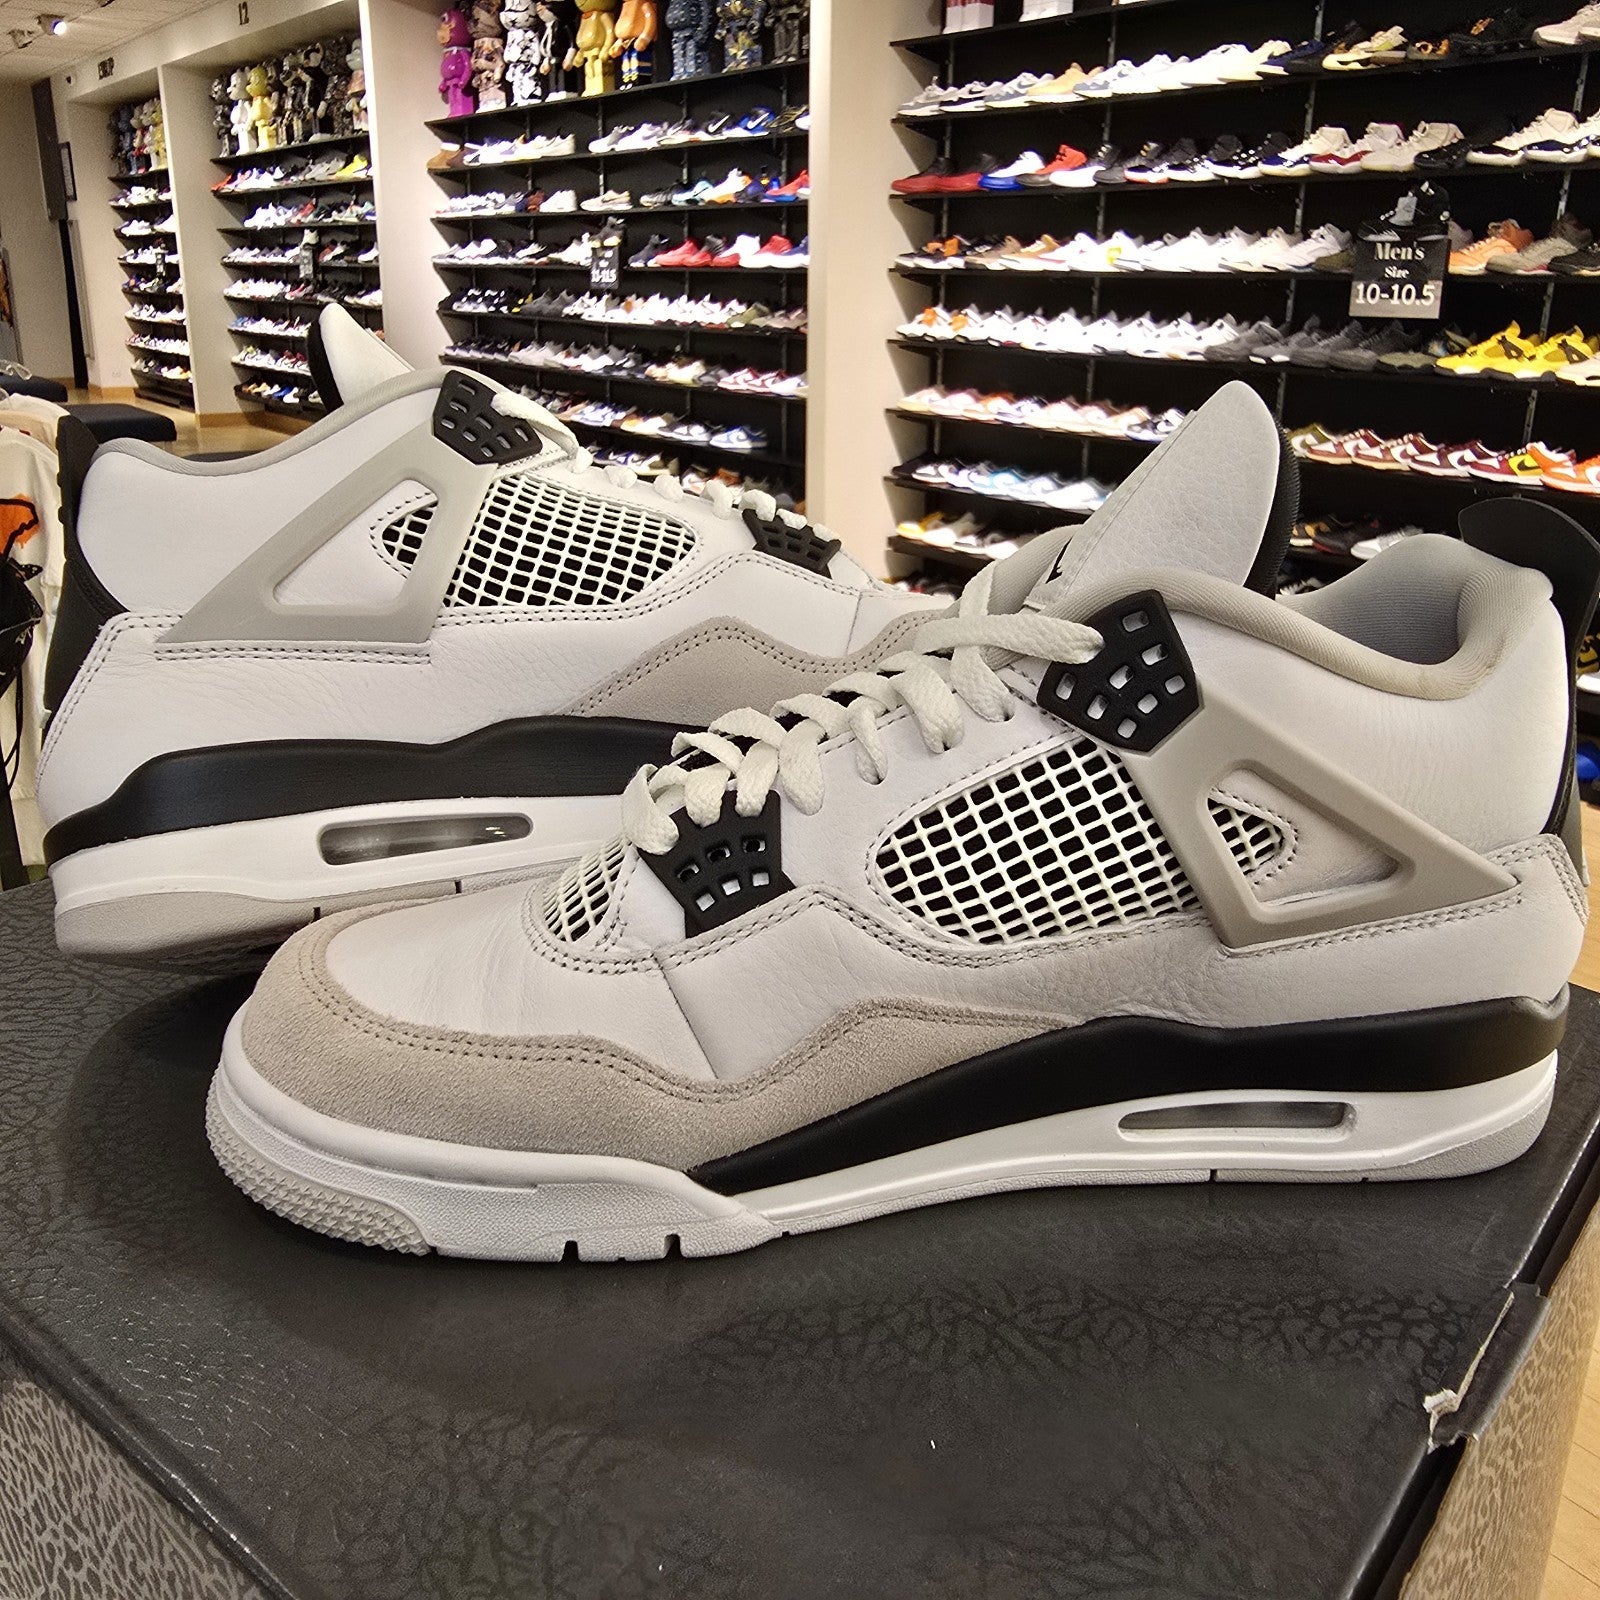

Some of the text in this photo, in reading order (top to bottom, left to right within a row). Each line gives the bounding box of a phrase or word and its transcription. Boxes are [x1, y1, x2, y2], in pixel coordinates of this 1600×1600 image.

[238, 1, 249, 25] 12
[1374, 241, 1425, 260] Men's
[1384, 266, 1410, 279] Size
[1355, 283, 1435, 306] 10-10.5
